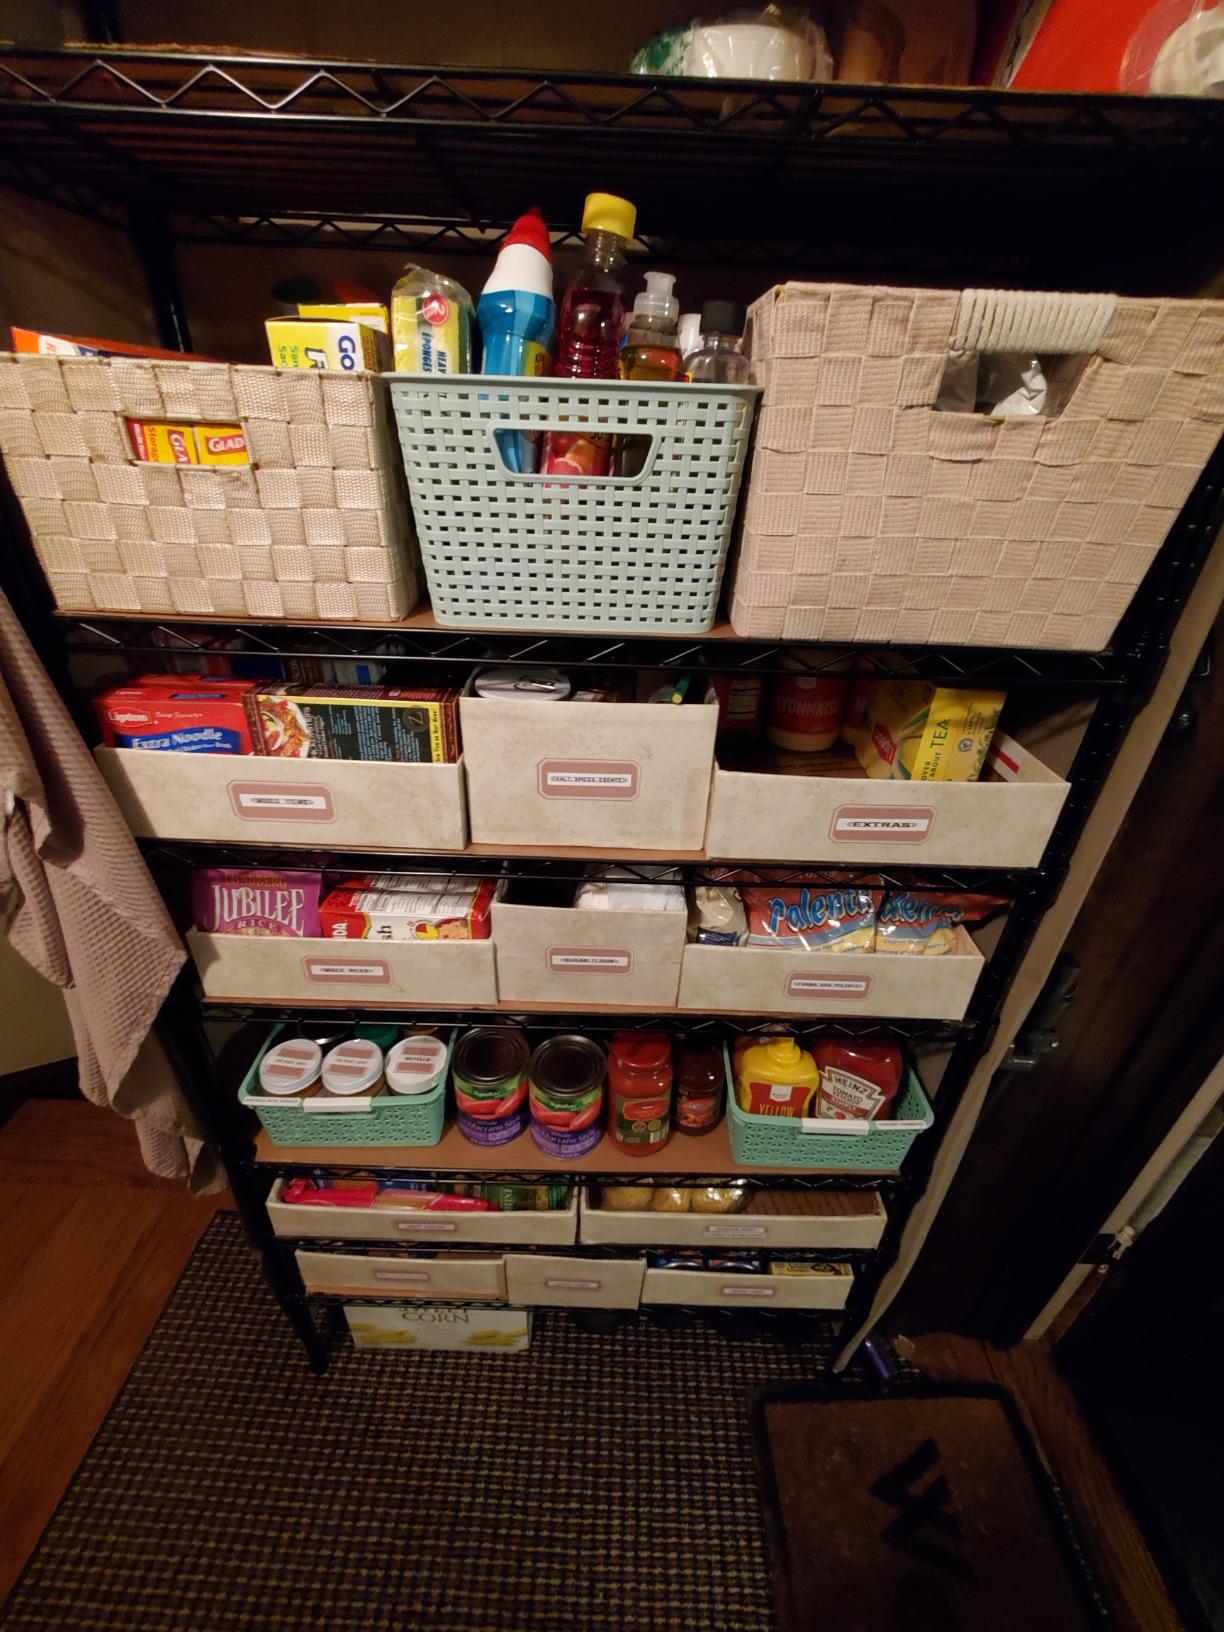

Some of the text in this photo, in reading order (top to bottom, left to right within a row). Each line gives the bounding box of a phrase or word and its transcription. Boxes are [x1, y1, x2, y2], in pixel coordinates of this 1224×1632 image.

[206, 434, 245, 454] GLAD
[107, 711, 150, 725] Lipton
[154, 711, 201, 720] Soup Secrets
[130, 736, 171, 751] Extra
[171, 727, 224, 746] Noodle
[930, 718, 953, 750] TEA
[929, 749, 942, 779] ABOUT
[851, 820, 912, 829] EXTRAS
[224, 873, 288, 889] LUNDBERG
[203, 883, 305, 938] JUBILEE
[768, 888, 874, 937] Polenta
[237, 919, 279, 932] RICE
[834, 1075, 870, 1094] HEINZ
[832, 1084, 864, 1105] TOMATO
[401, 1312, 470, 1324] CORN
